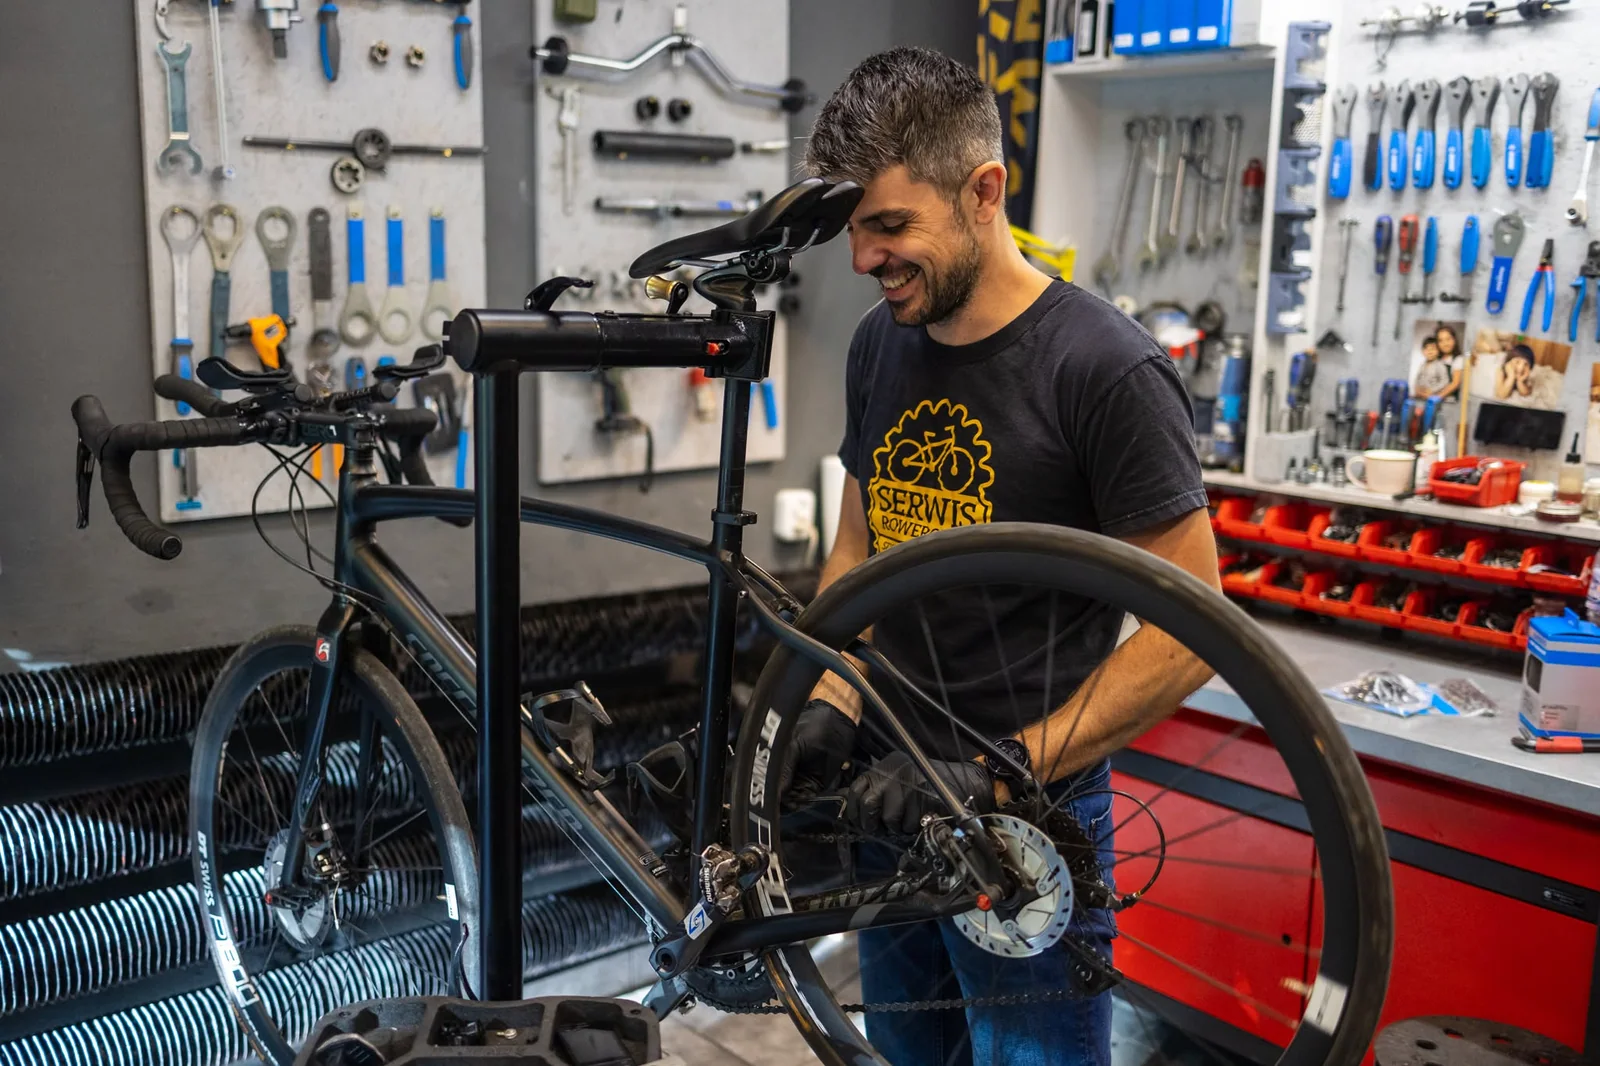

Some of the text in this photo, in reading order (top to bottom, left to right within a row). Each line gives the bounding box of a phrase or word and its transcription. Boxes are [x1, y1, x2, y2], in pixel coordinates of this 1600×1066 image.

[876, 486, 977, 528] SERWIS
[197, 830, 208, 858] DT
[200, 859, 216, 907] SWISS
[703, 867, 713, 903] SHIMANO
